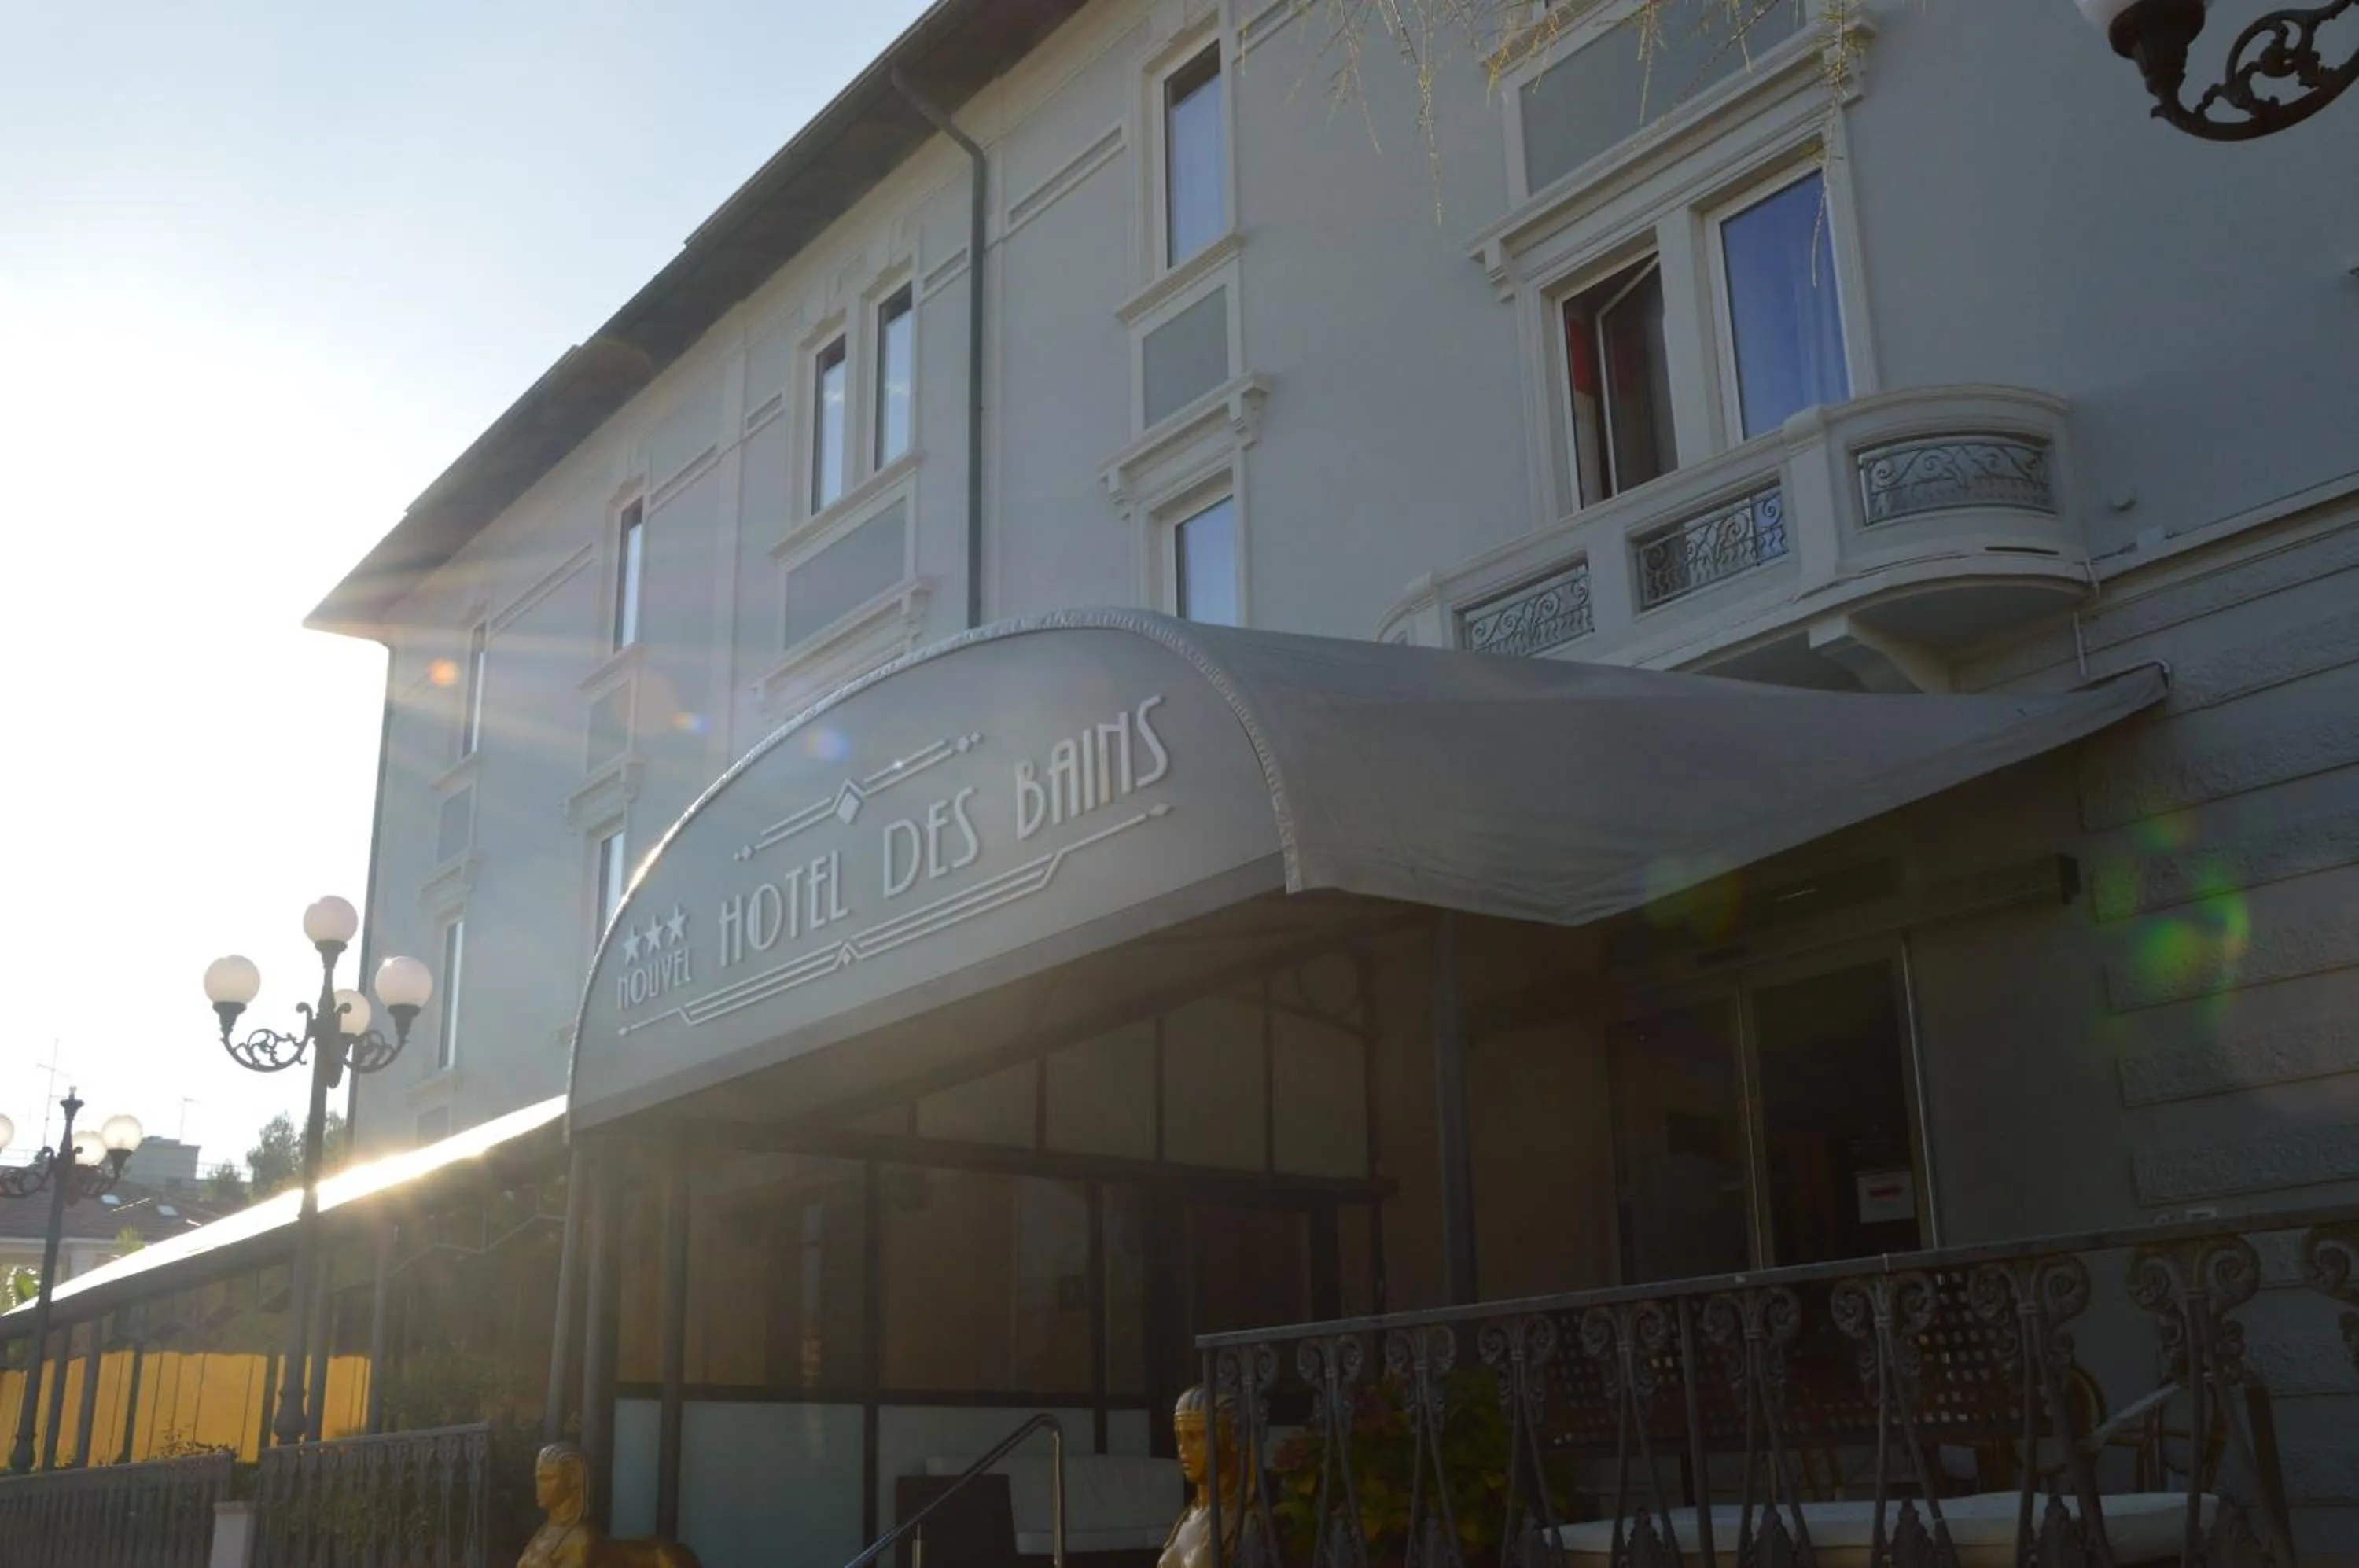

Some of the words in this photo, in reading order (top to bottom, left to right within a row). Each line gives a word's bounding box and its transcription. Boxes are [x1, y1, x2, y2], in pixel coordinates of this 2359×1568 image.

[617, 946, 692, 1010] NOUVEL
[719, 850, 849, 966] HOTEL
[883, 786, 979, 898] DES
[1014, 694, 1168, 840] BAINS
